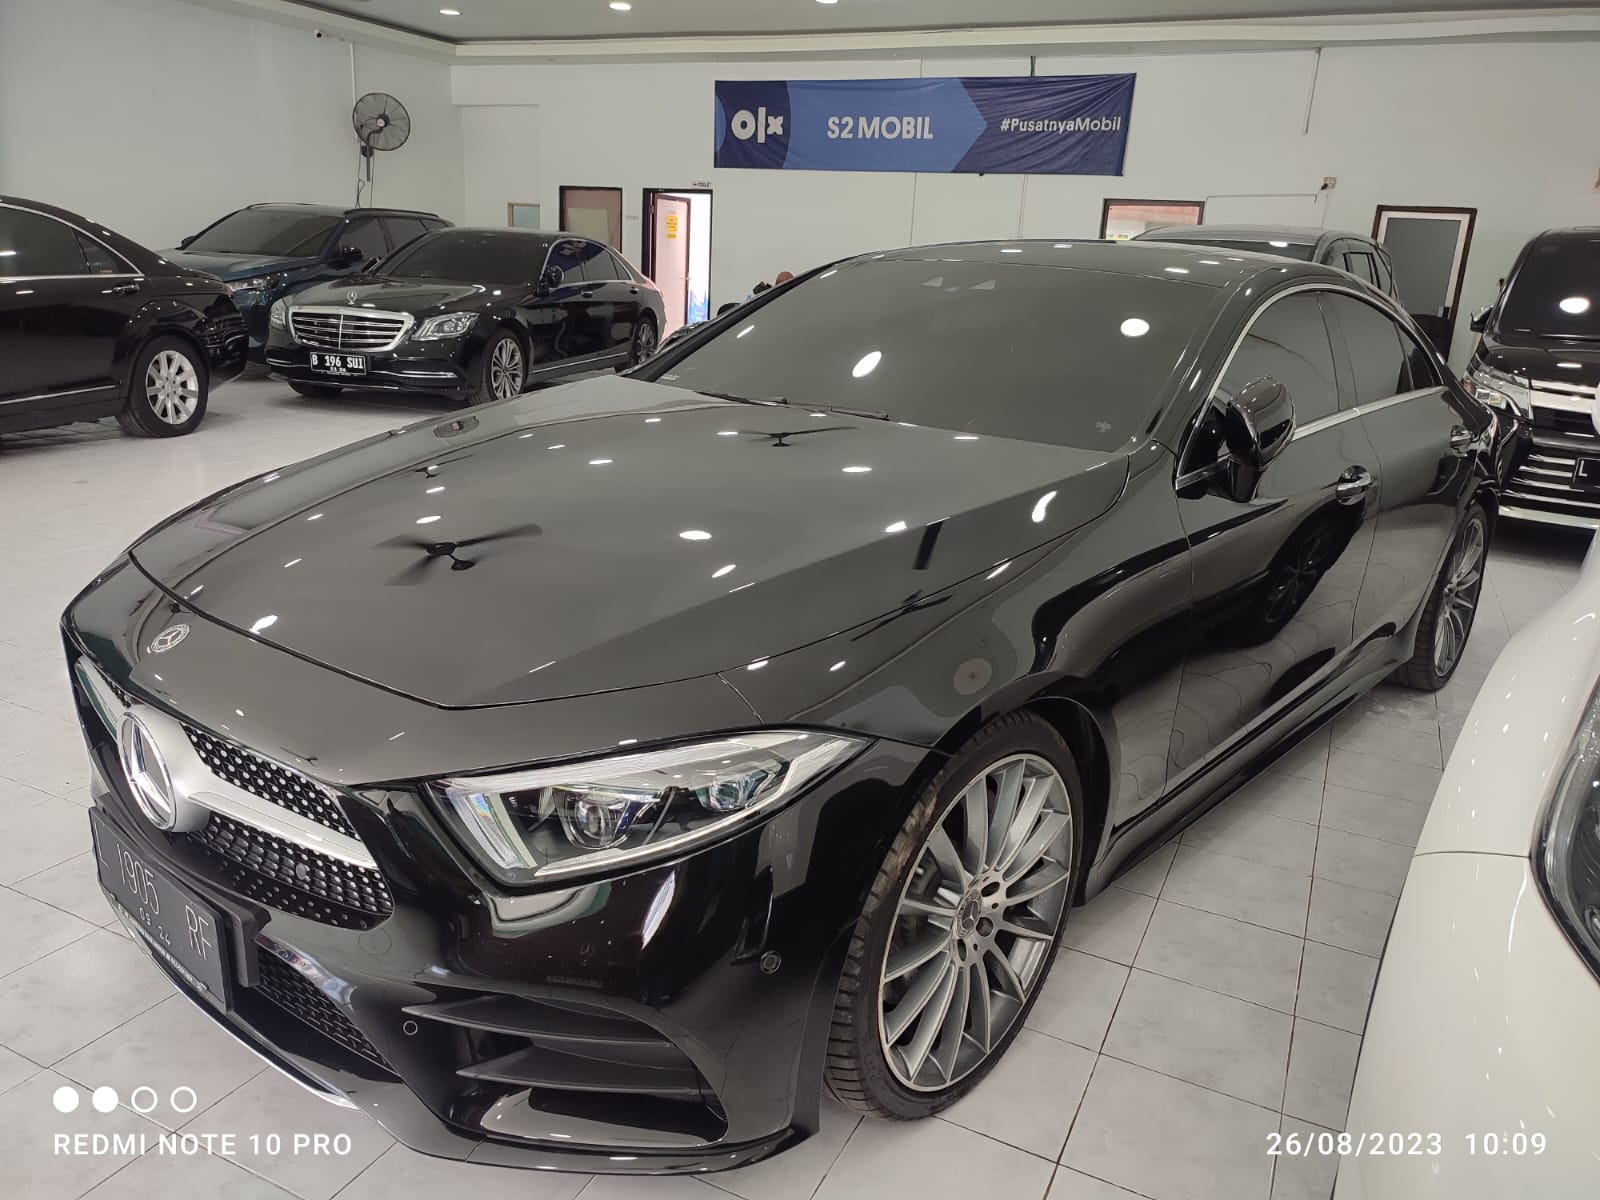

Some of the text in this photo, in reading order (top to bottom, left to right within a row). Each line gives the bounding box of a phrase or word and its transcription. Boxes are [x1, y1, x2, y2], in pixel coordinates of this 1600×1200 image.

[827, 116, 934, 139] S2 MOBIL
[1000, 117, 1121, 134] #PusatnyaMobil
[312, 354, 363, 368] B 196 SUI
[1578, 460, 1588, 477] L
[94, 822, 109, 867] L
[117, 843, 159, 915] 1905
[185, 904, 212, 960] RF
